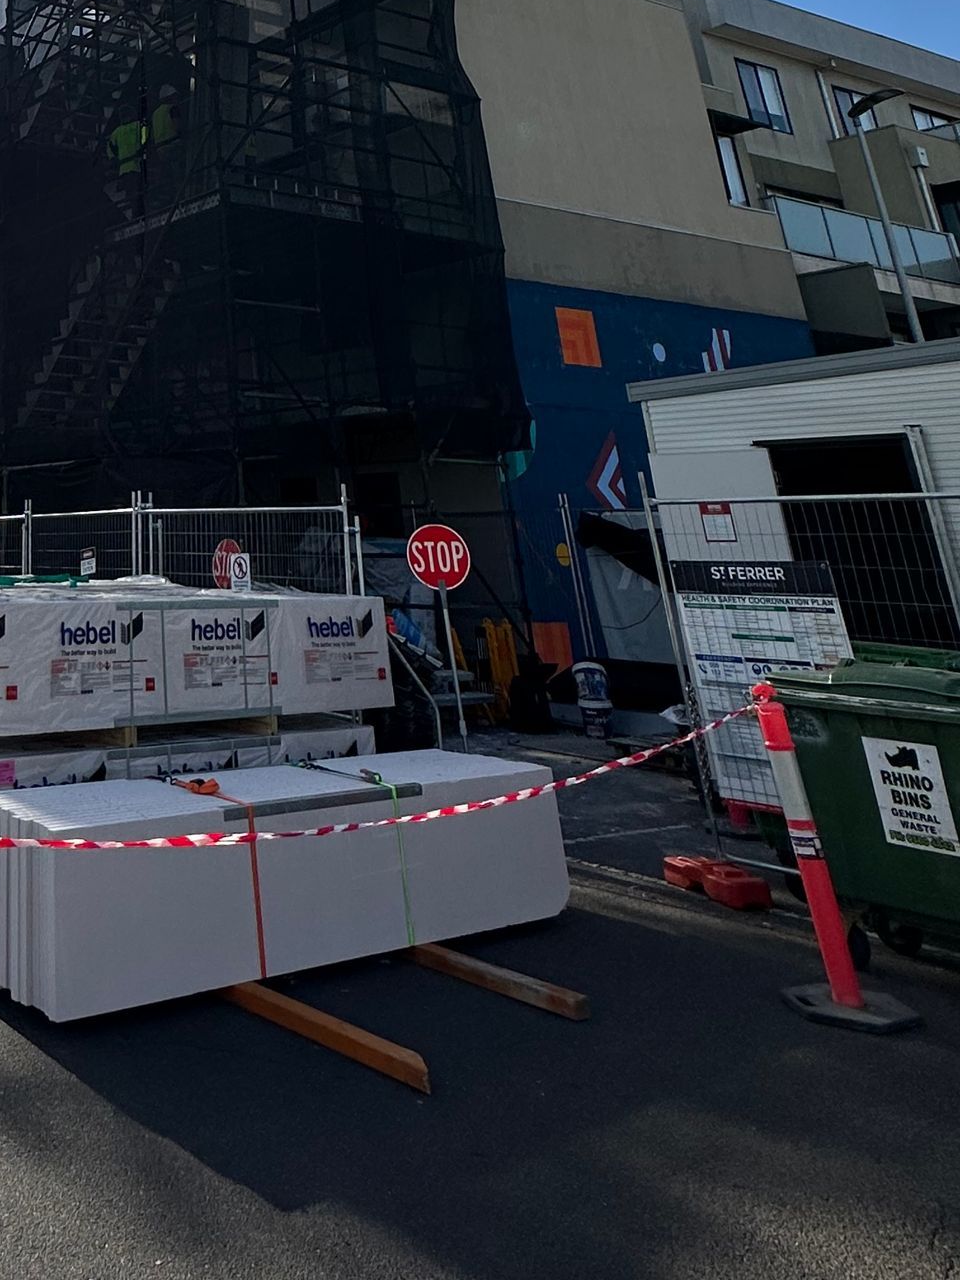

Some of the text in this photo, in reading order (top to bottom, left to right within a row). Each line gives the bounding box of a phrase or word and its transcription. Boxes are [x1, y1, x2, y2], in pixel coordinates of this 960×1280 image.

[411, 541, 464, 573] STOP
[730, 568, 786, 581] FERRER
[681, 595, 711, 603] HEALTH
[718, 596, 747, 604] SAFETY
[748, 597, 809, 606] COORDINATION
[810, 598, 834, 607] PLAN
[61, 620, 116, 646] hebel
[191, 617, 241, 641] hebel
[307, 614, 354, 638] hebel
[880, 770, 934, 792] RHINO
[890, 789, 932, 810] BINS
[891, 808, 941, 824] GENERAL
[900, 820, 937, 834] WASTE
